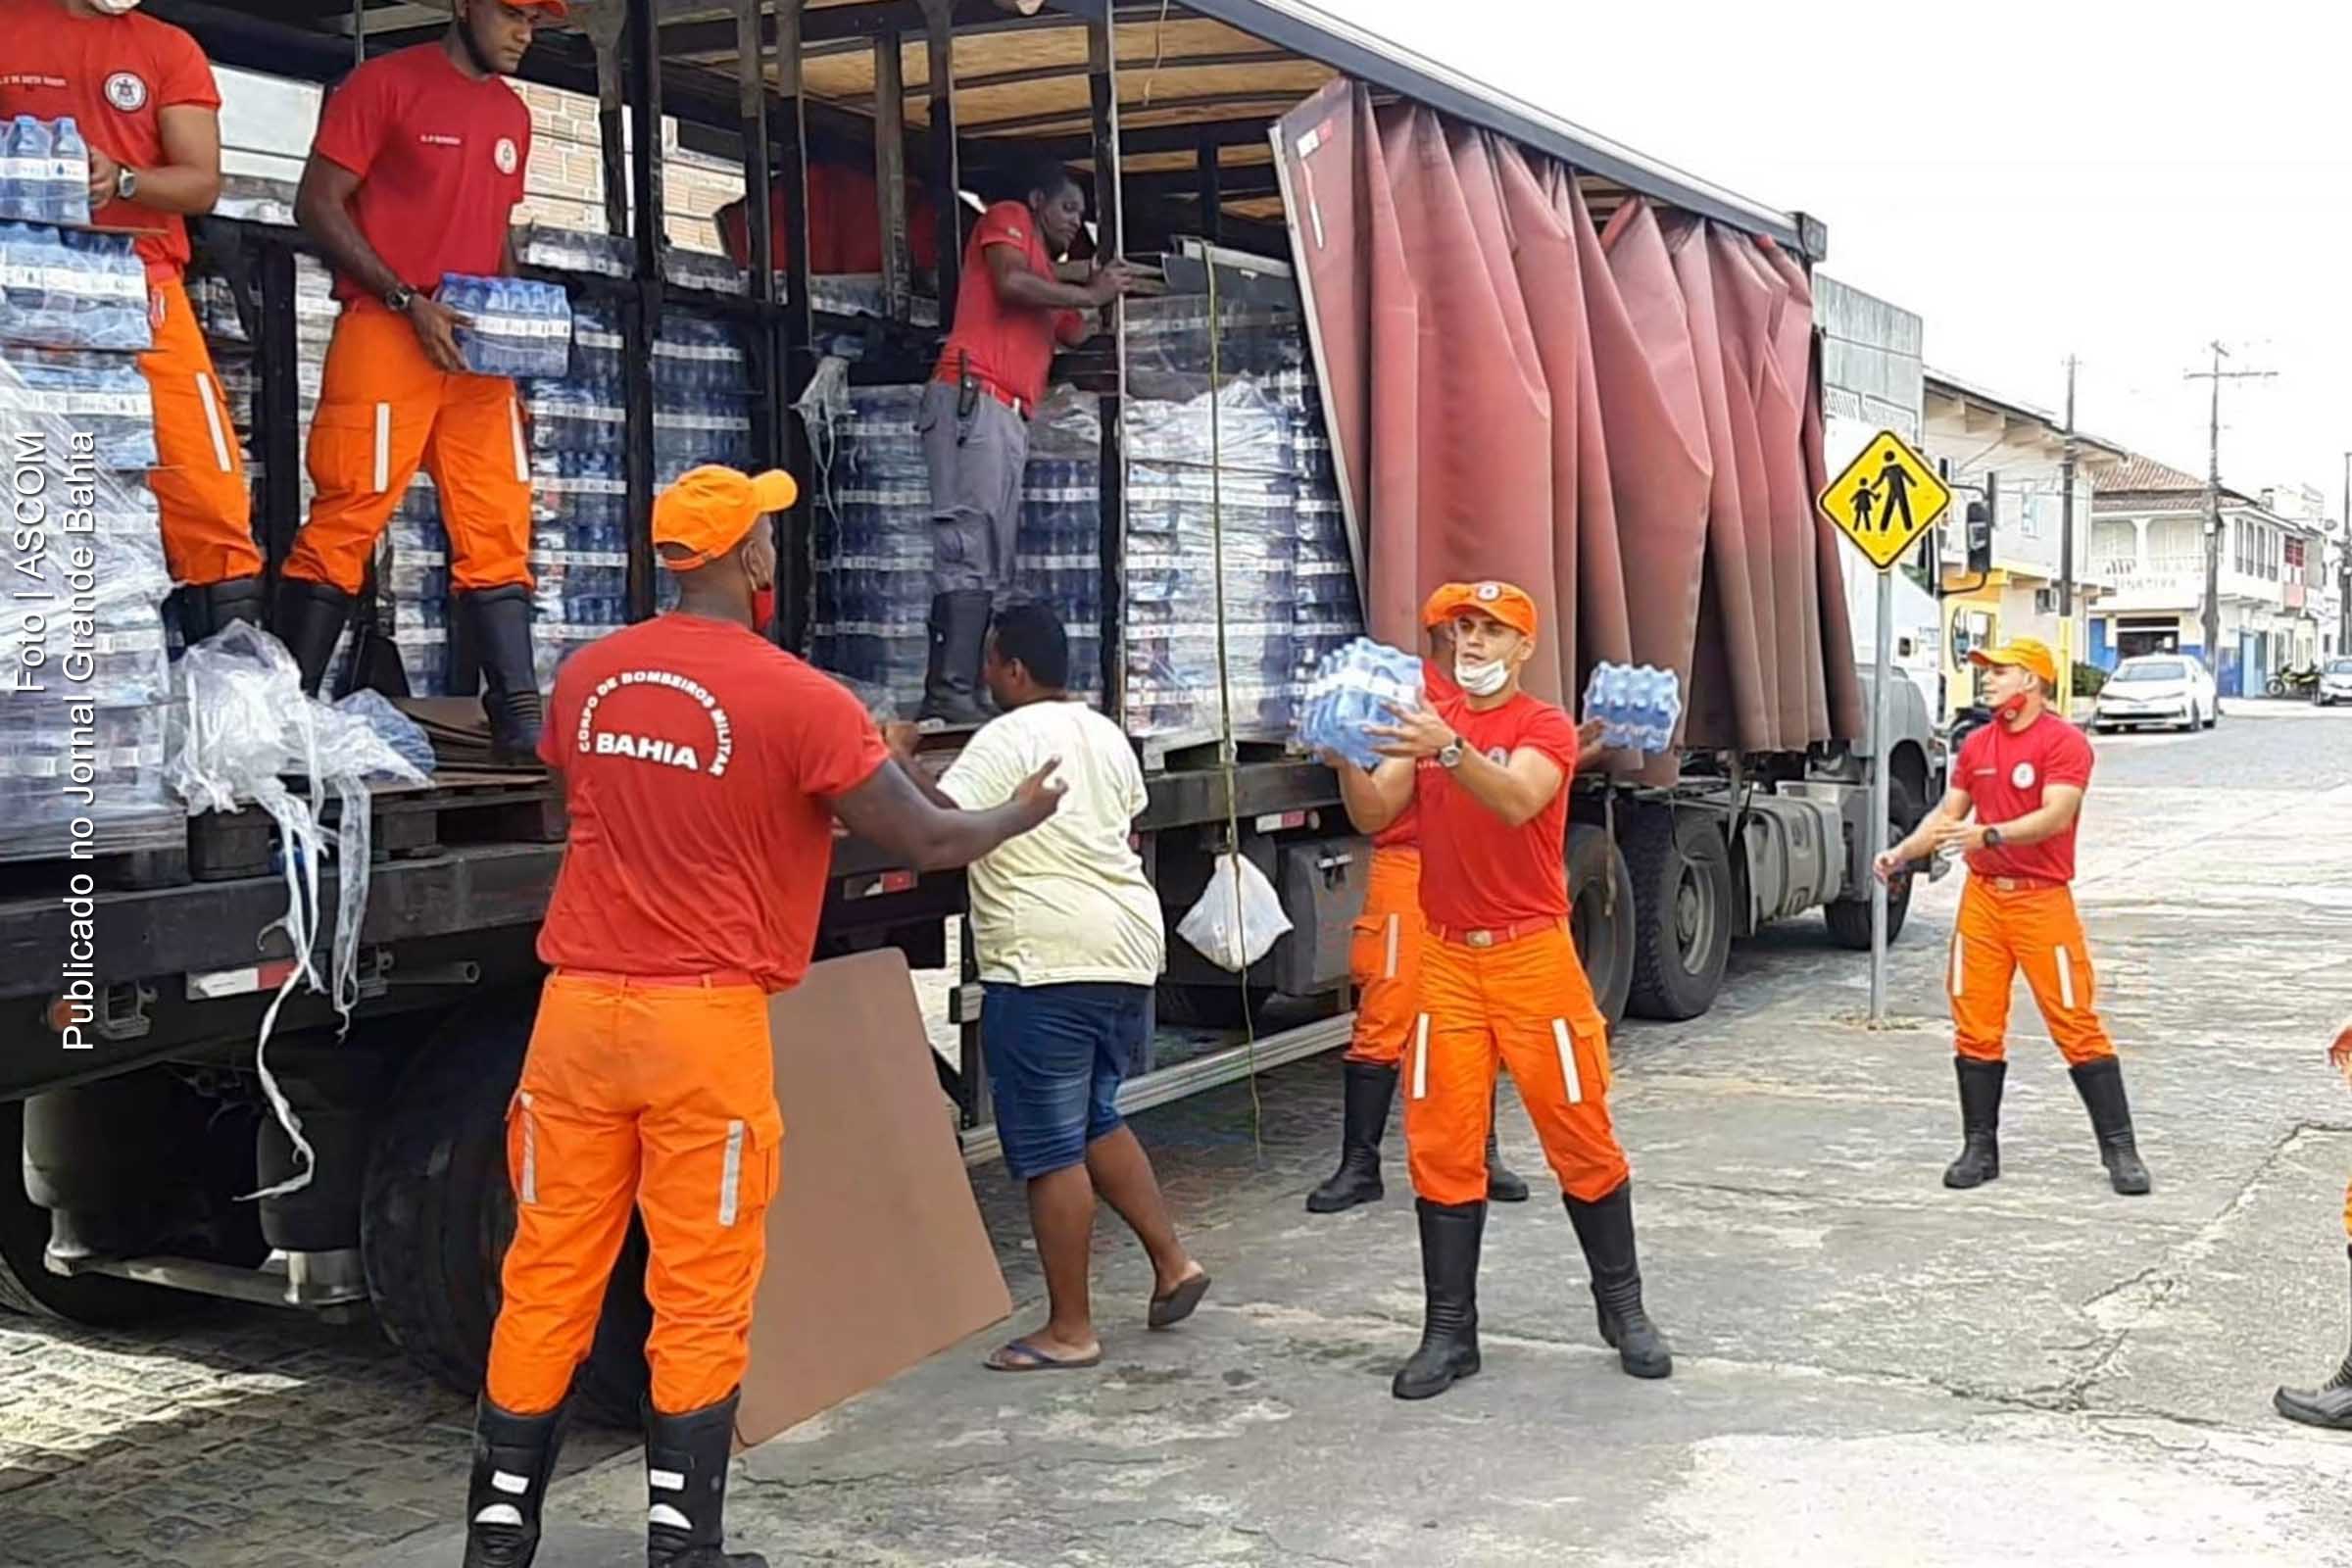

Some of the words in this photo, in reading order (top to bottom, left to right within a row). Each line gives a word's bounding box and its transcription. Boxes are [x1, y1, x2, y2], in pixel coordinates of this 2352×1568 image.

[578, 695, 598, 752] CORPO
[596, 676, 618, 697] DE
[621, 670, 716, 708] BOMBEIROS
[710, 709, 732, 776] MILITAR
[597, 733, 698, 770] BAHIA
